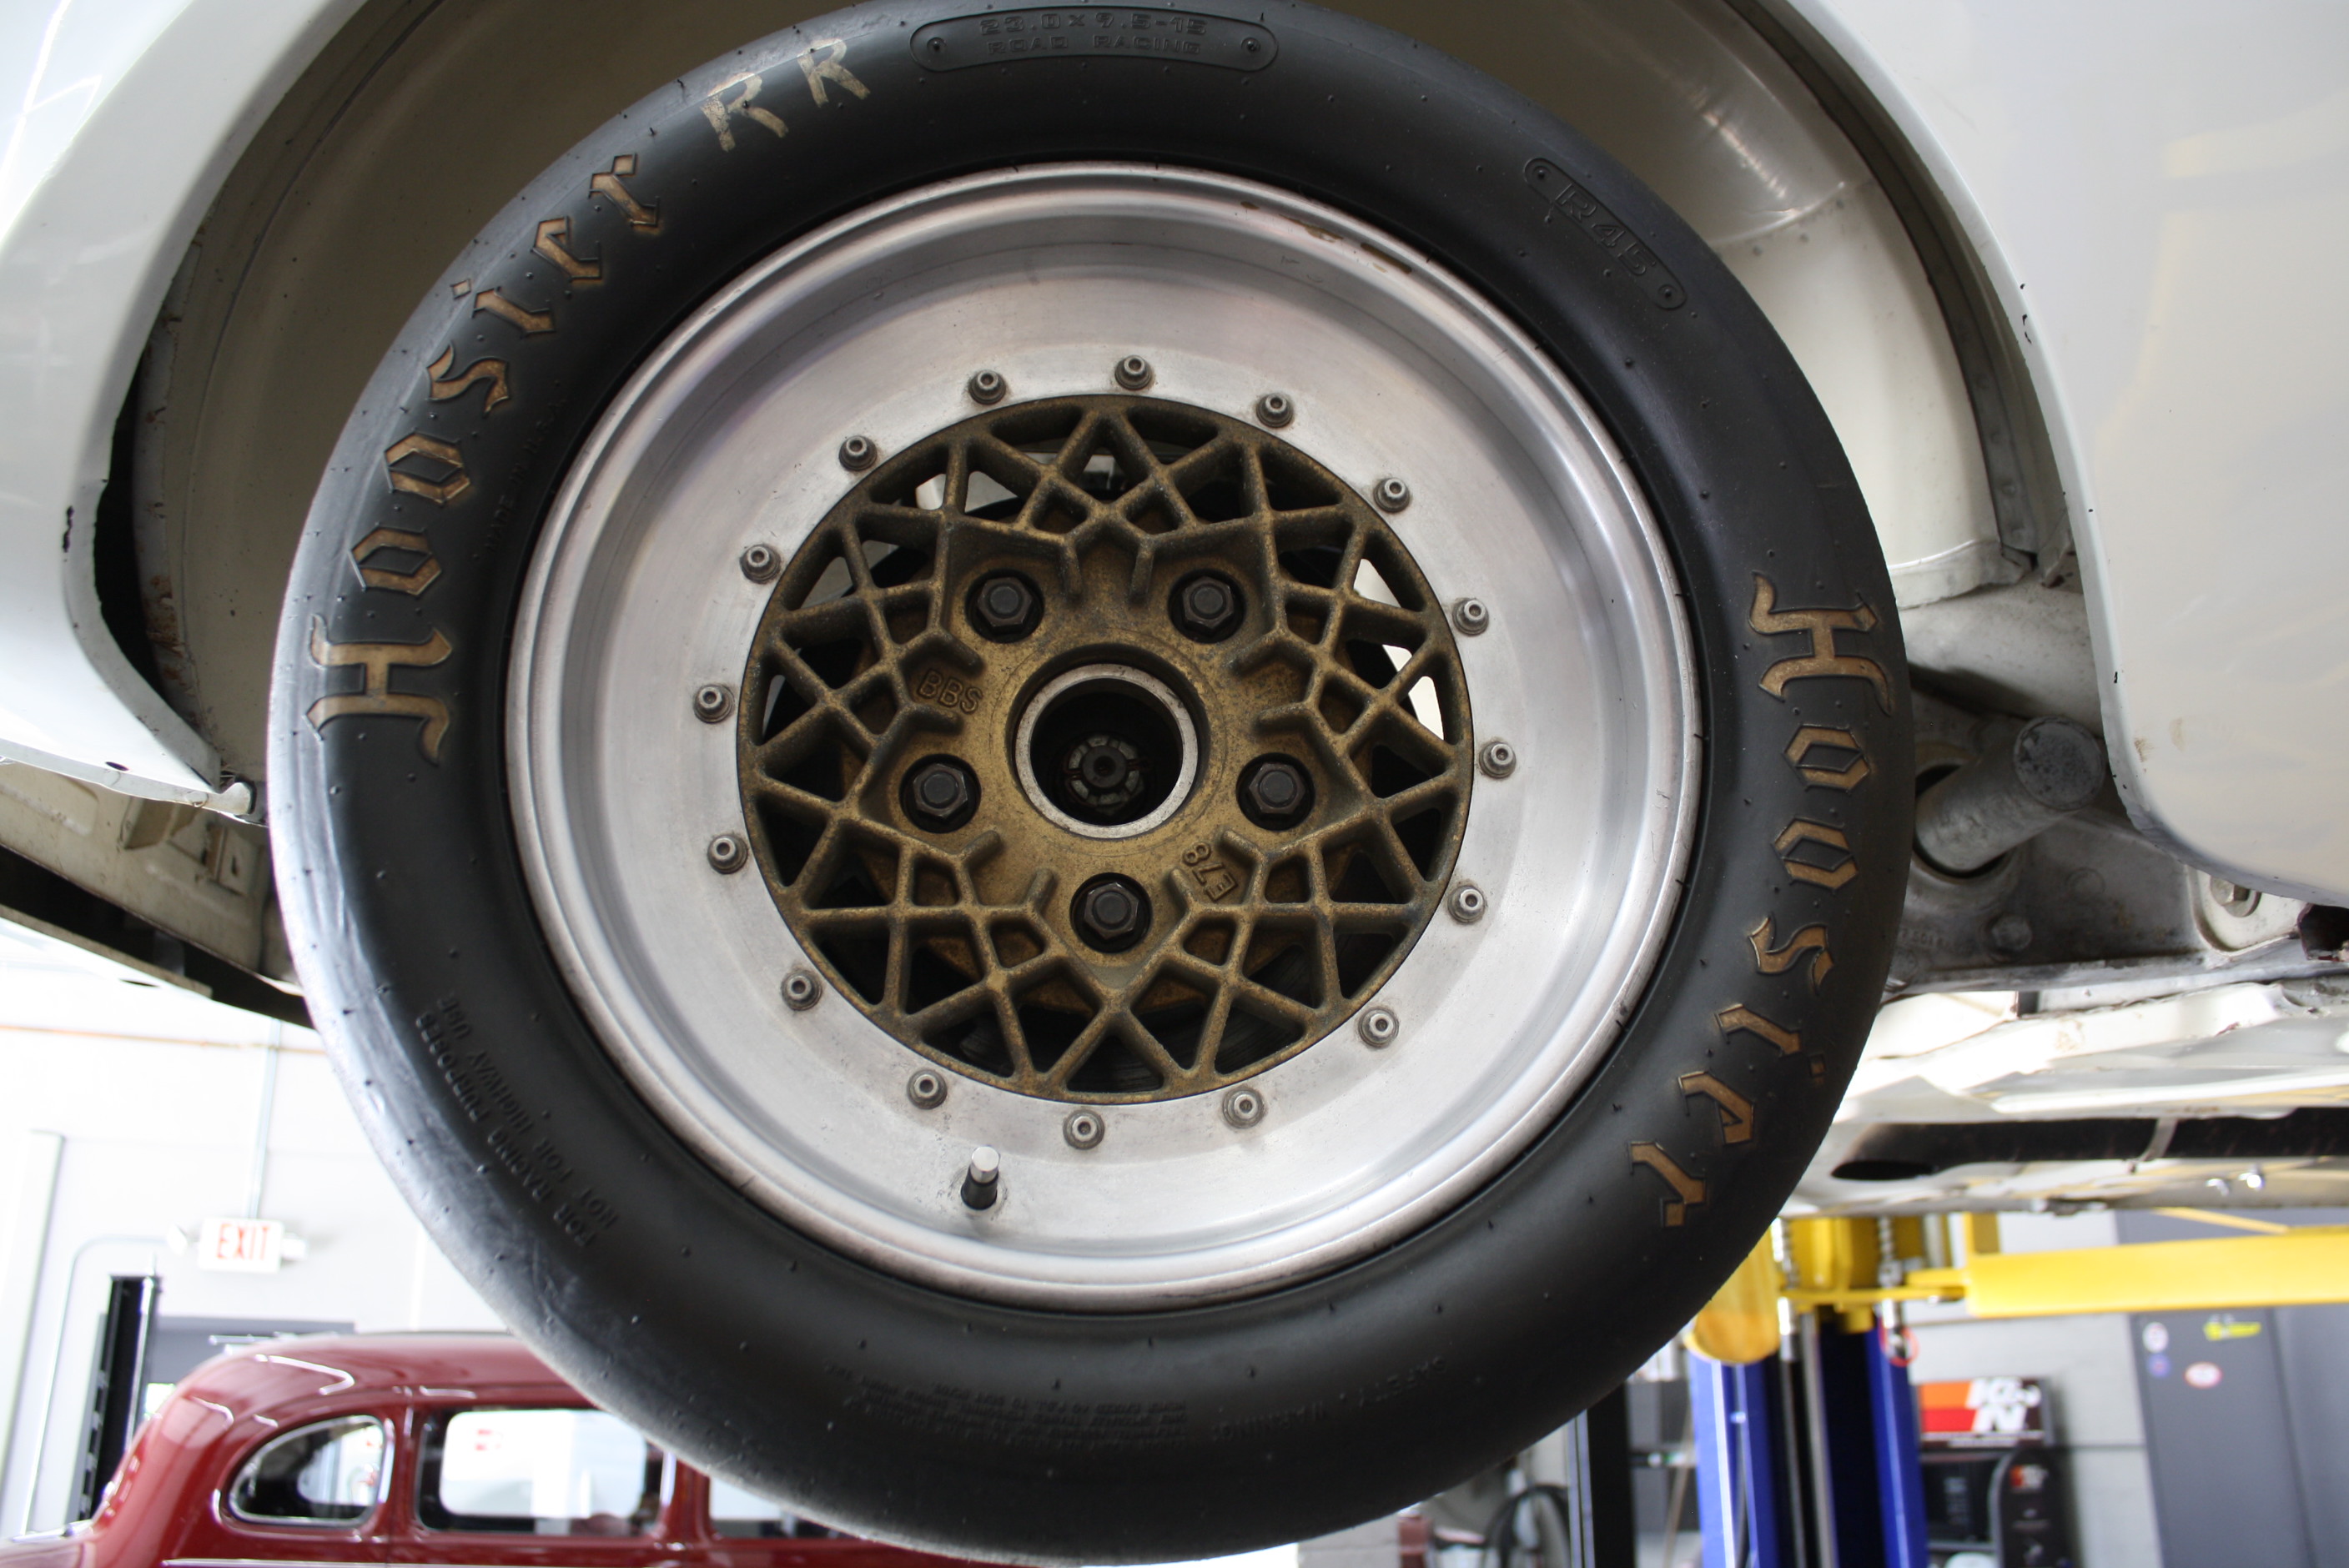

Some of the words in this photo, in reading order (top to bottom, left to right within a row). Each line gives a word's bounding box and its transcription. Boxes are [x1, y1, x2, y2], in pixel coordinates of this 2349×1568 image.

[988, 36, 1068, 55] ROAD
[1093, 34, 1202, 55] RACING
[302, 153, 659, 767] Hoosier
[917, 668, 983, 715] BBS
[1629, 571, 1895, 1227] Hoosier
[414, 1010, 493, 1123] PURPOSES
[468, 1050, 532, 1133] HIGHWAY
[487, 1125, 553, 1205] RACING
[216, 1223, 271, 1260] EXIT
[554, 1200, 597, 1247] FOR
